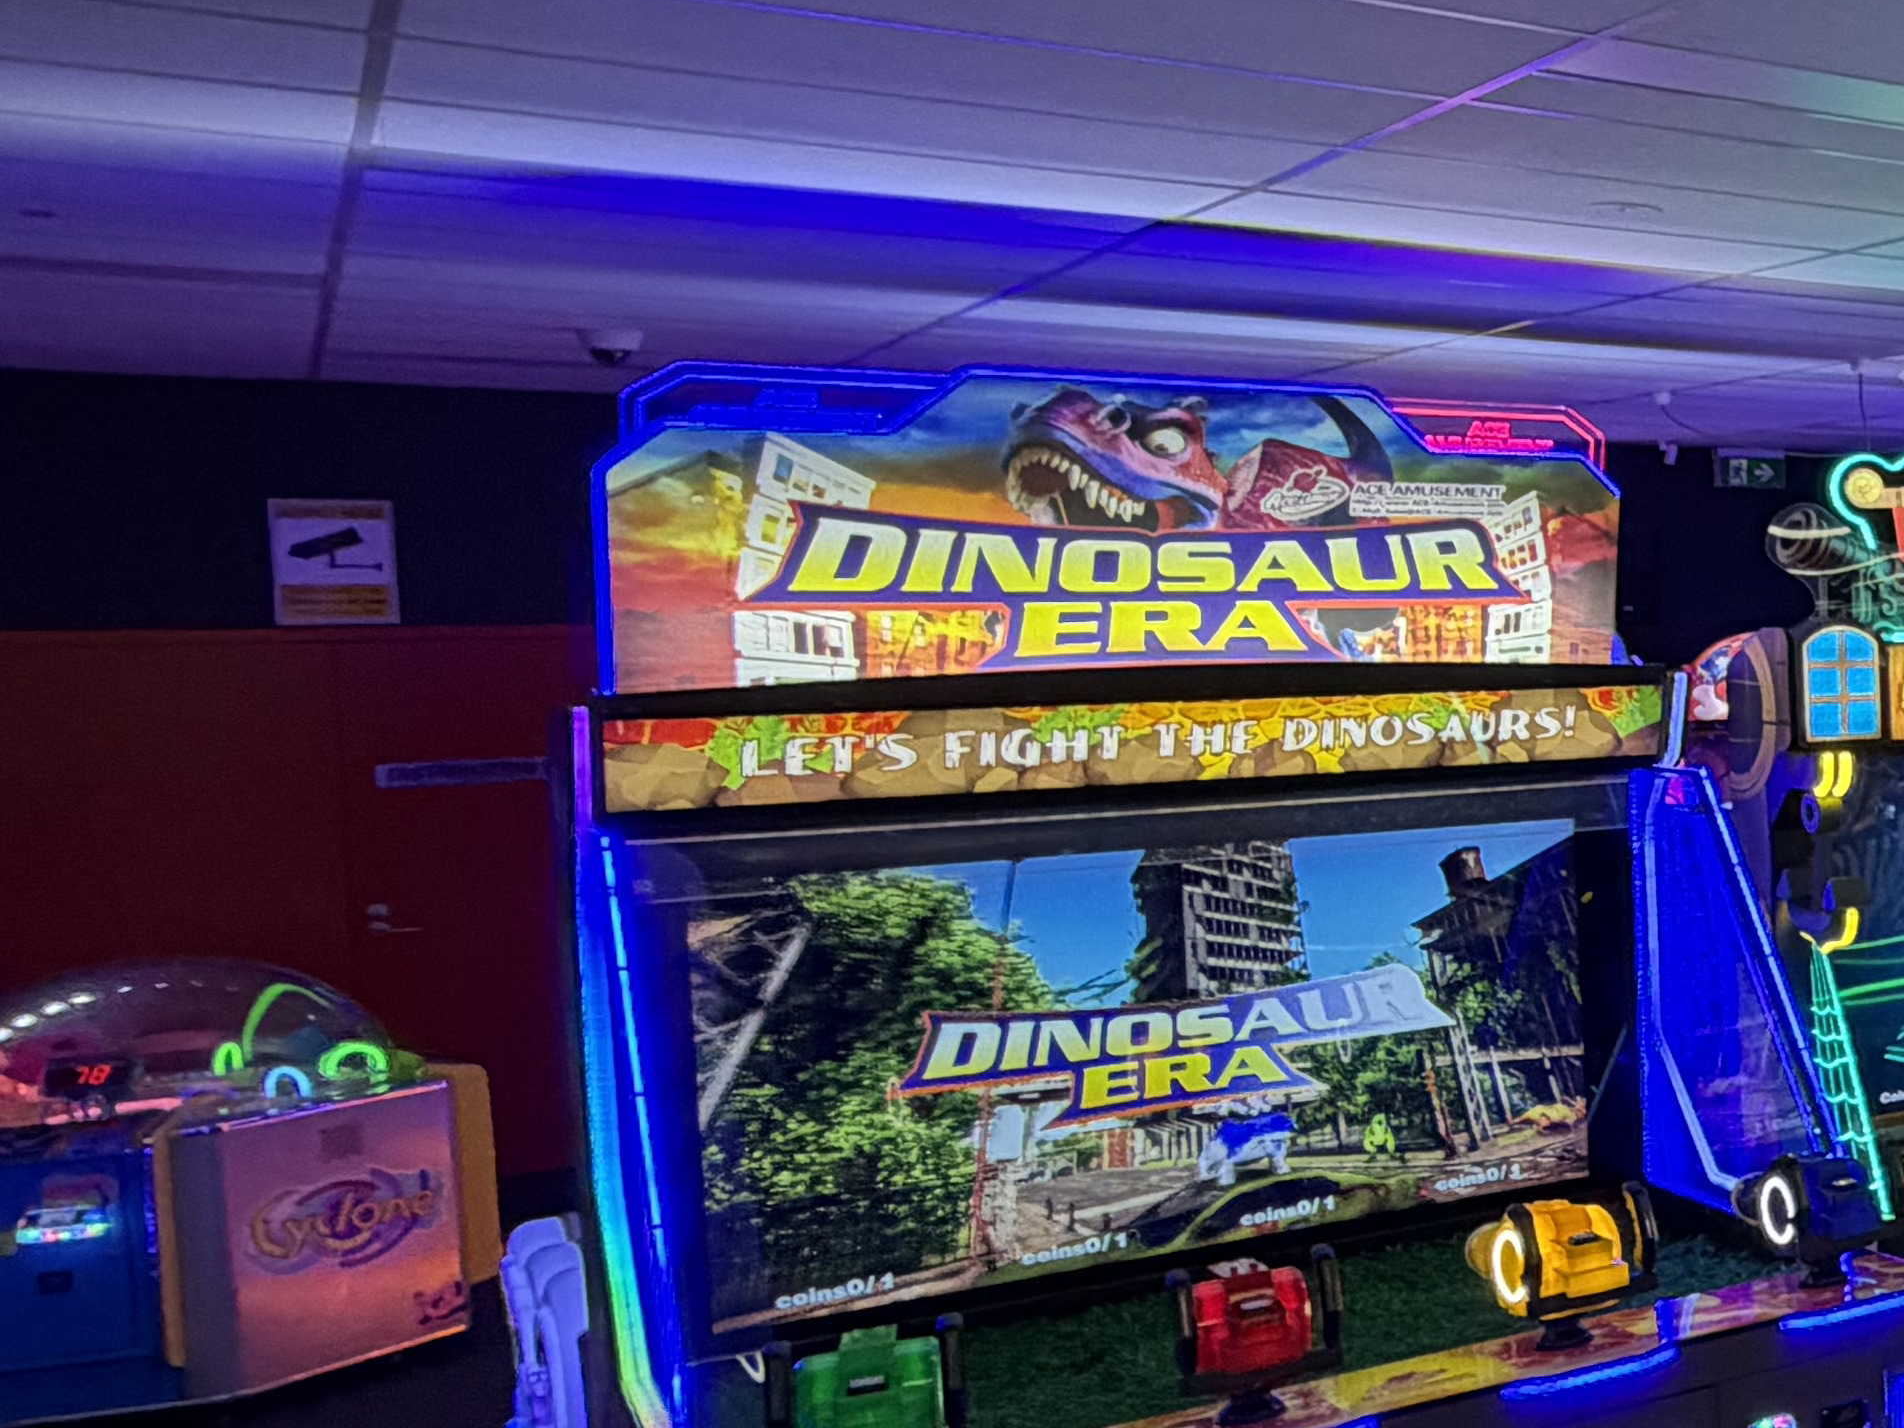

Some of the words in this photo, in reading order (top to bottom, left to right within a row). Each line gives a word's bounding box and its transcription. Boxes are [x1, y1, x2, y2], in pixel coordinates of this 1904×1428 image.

[1355, 485, 1389, 496] ACE
[1390, 486, 1502, 499] AMUSEMENT
[788, 519, 1496, 595] DINOSAUR
[1012, 598, 1302, 658] ERA
[738, 730, 920, 780] LET'S
[943, 725, 1122, 772] FIGHT
[1155, 718, 1260, 761] THE
[1281, 707, 1577, 751] DINOSAURS!
[920, 976, 1428, 1080] DINOSAUR
[1078, 1044, 1292, 1111] ERA
